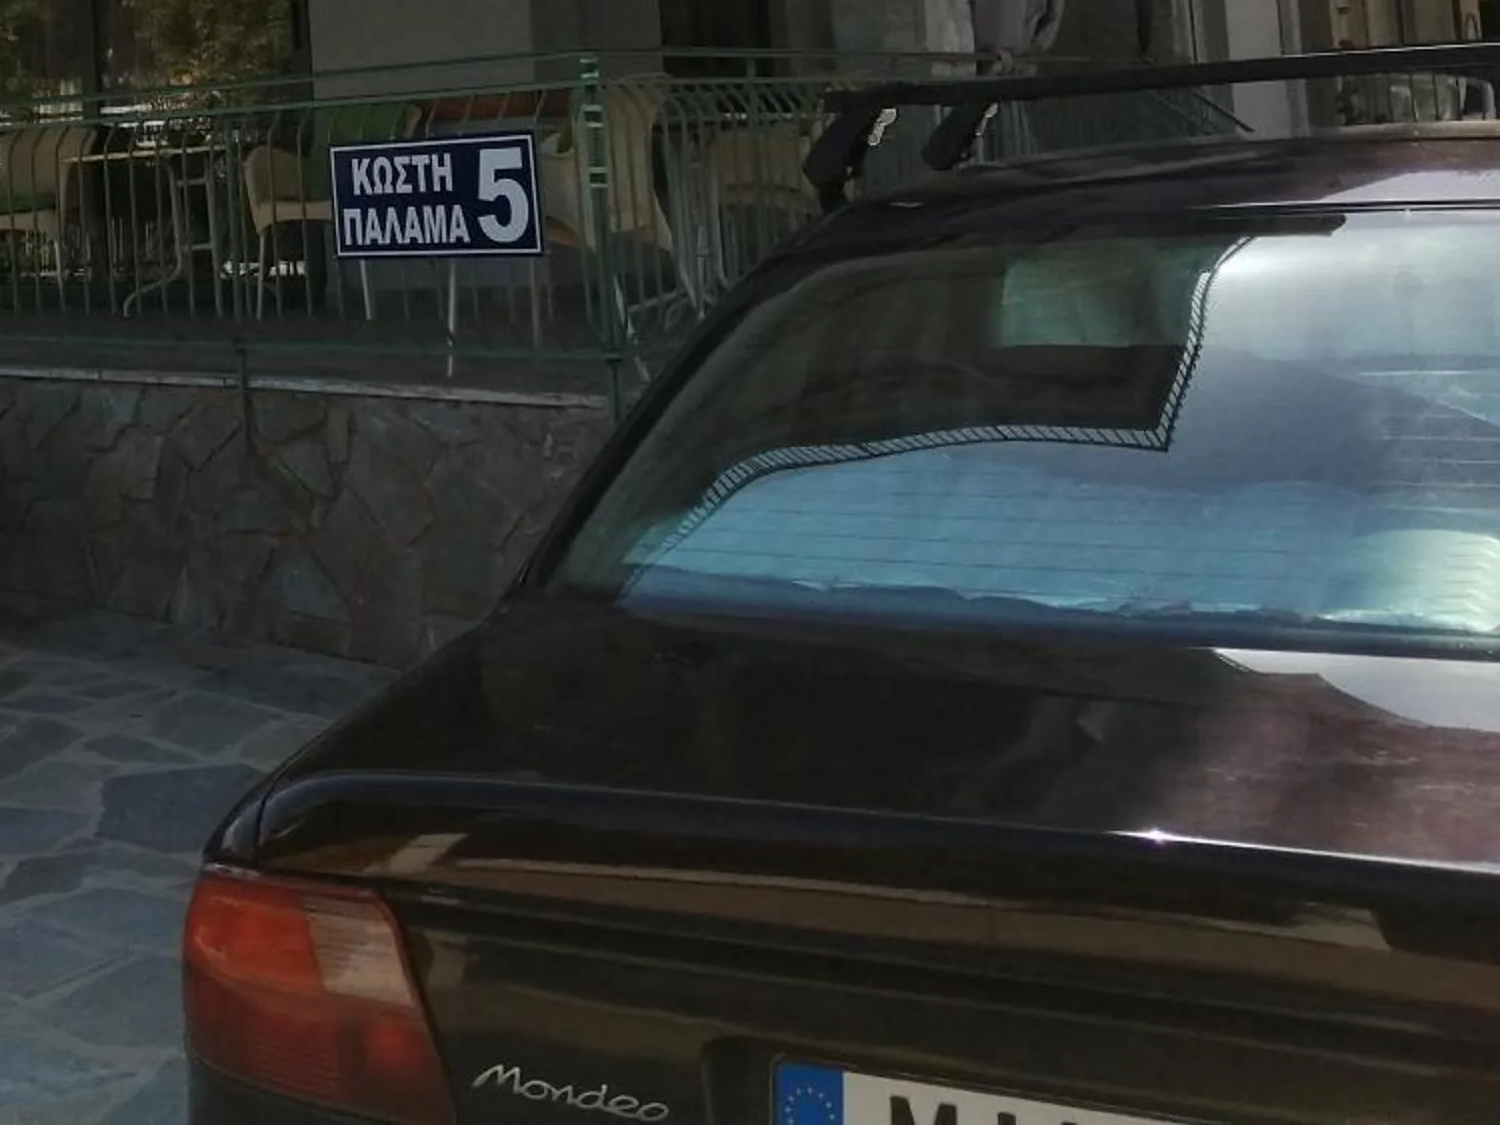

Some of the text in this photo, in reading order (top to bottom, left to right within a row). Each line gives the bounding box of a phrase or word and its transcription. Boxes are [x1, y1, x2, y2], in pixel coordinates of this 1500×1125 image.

[351, 152, 453, 196] ΚΩΣΤΗ
[476, 146, 530, 244] 5
[342, 204, 471, 246] ΠΑΛΑΜΑ
[470, 1063, 670, 1122] Mondeo
